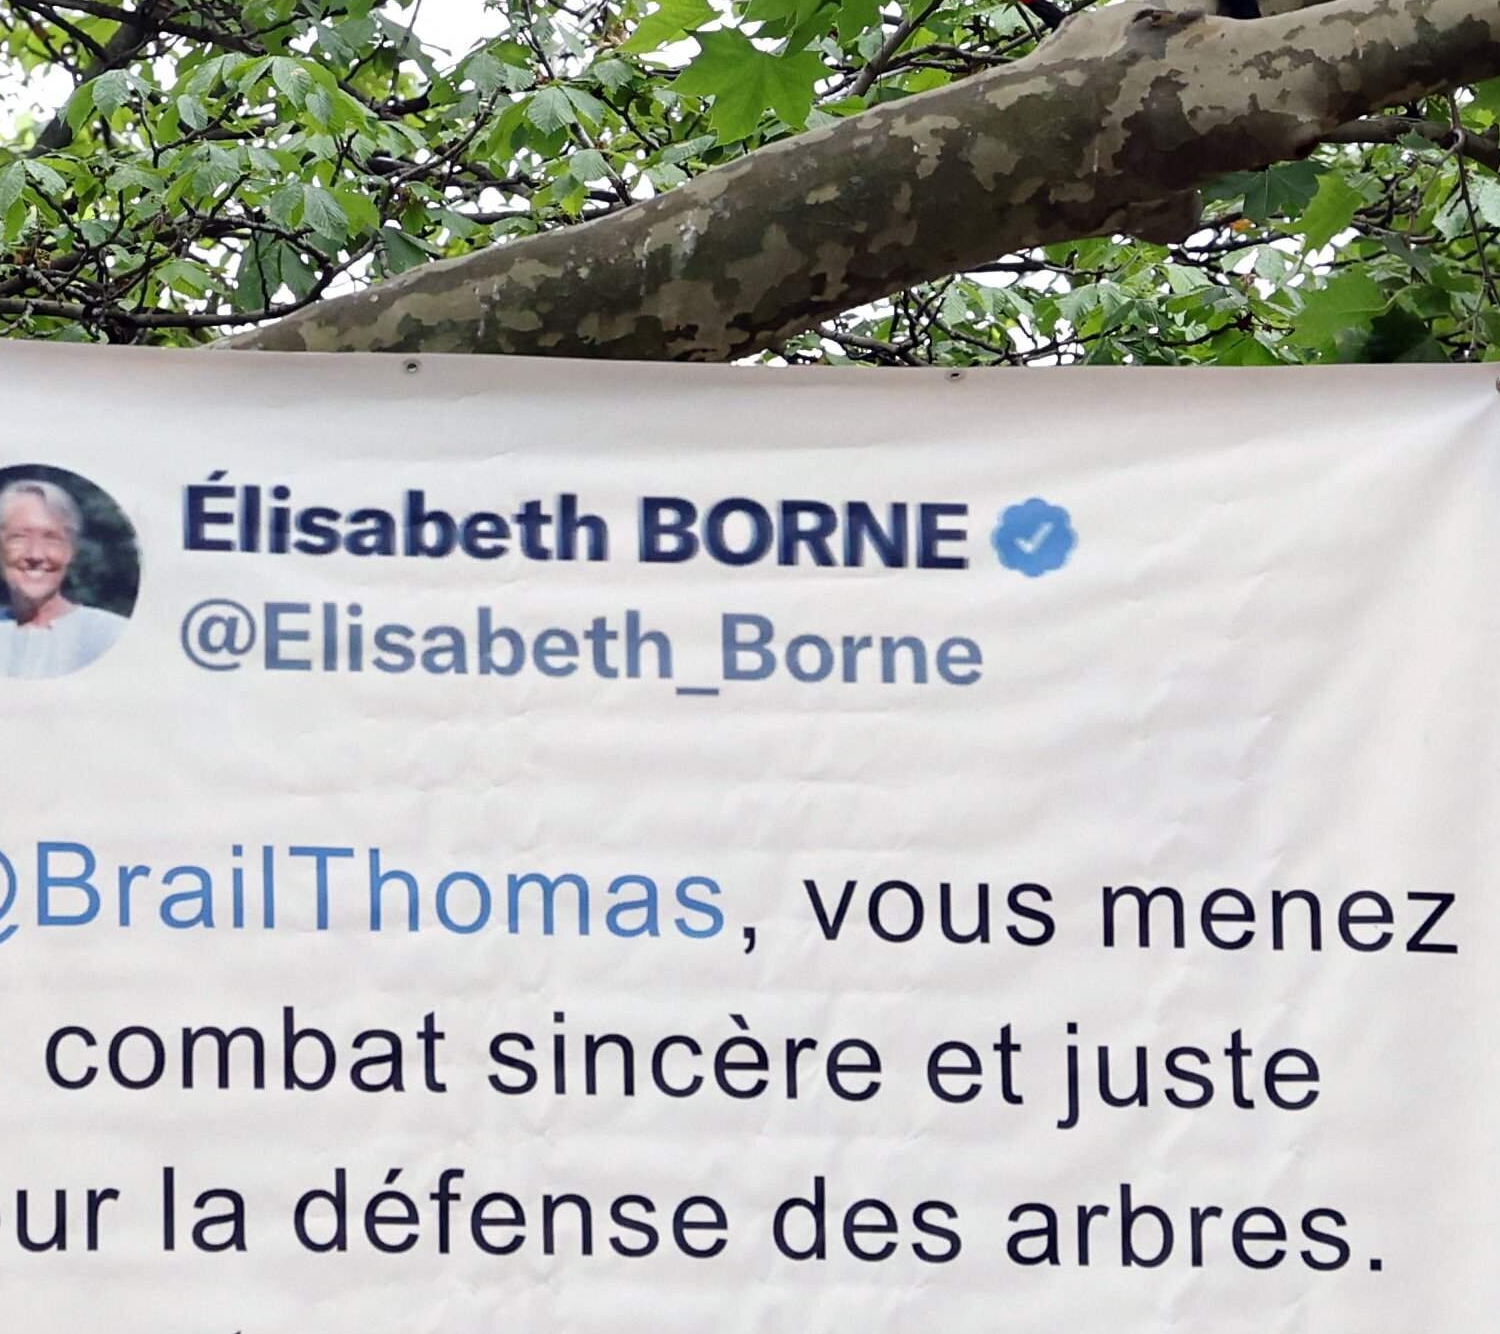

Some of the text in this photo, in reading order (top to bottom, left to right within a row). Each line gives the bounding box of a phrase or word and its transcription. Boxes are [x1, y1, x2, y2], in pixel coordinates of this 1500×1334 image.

[181, 468, 971, 572] Élisabeth BORNE
[179, 597, 984, 698] @Elisabeth_Borne
[801, 878, 1057, 949] vous
[1100, 884, 1460, 956] menez
[43, 1004, 449, 1095] combat
[486, 1009, 884, 1104] sincère
[925, 1021, 1026, 1107] et
[1055, 1020, 1322, 1131] juste
[161, 1164, 249, 1254] la
[292, 1166, 730, 1261] défense
[771, 1174, 963, 1265] des
[1005, 1181, 1384, 1273] arbres.
